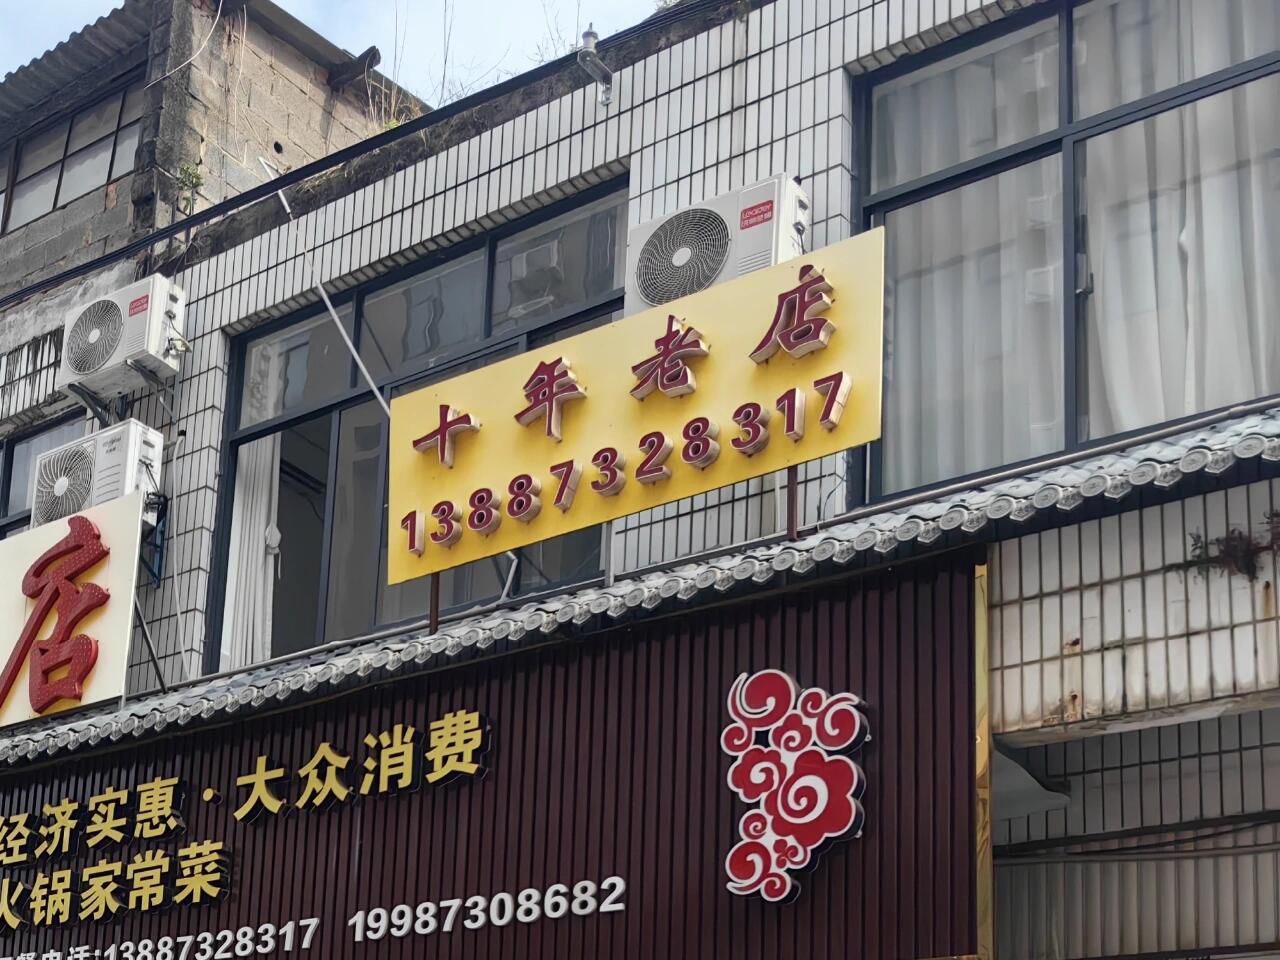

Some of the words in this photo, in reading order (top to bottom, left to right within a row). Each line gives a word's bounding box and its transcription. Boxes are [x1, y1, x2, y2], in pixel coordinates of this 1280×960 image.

[412, 264, 838, 467] 十年老店
[401, 370, 853, 558] 13887328317
[347, 876, 627, 943] 19987308682
